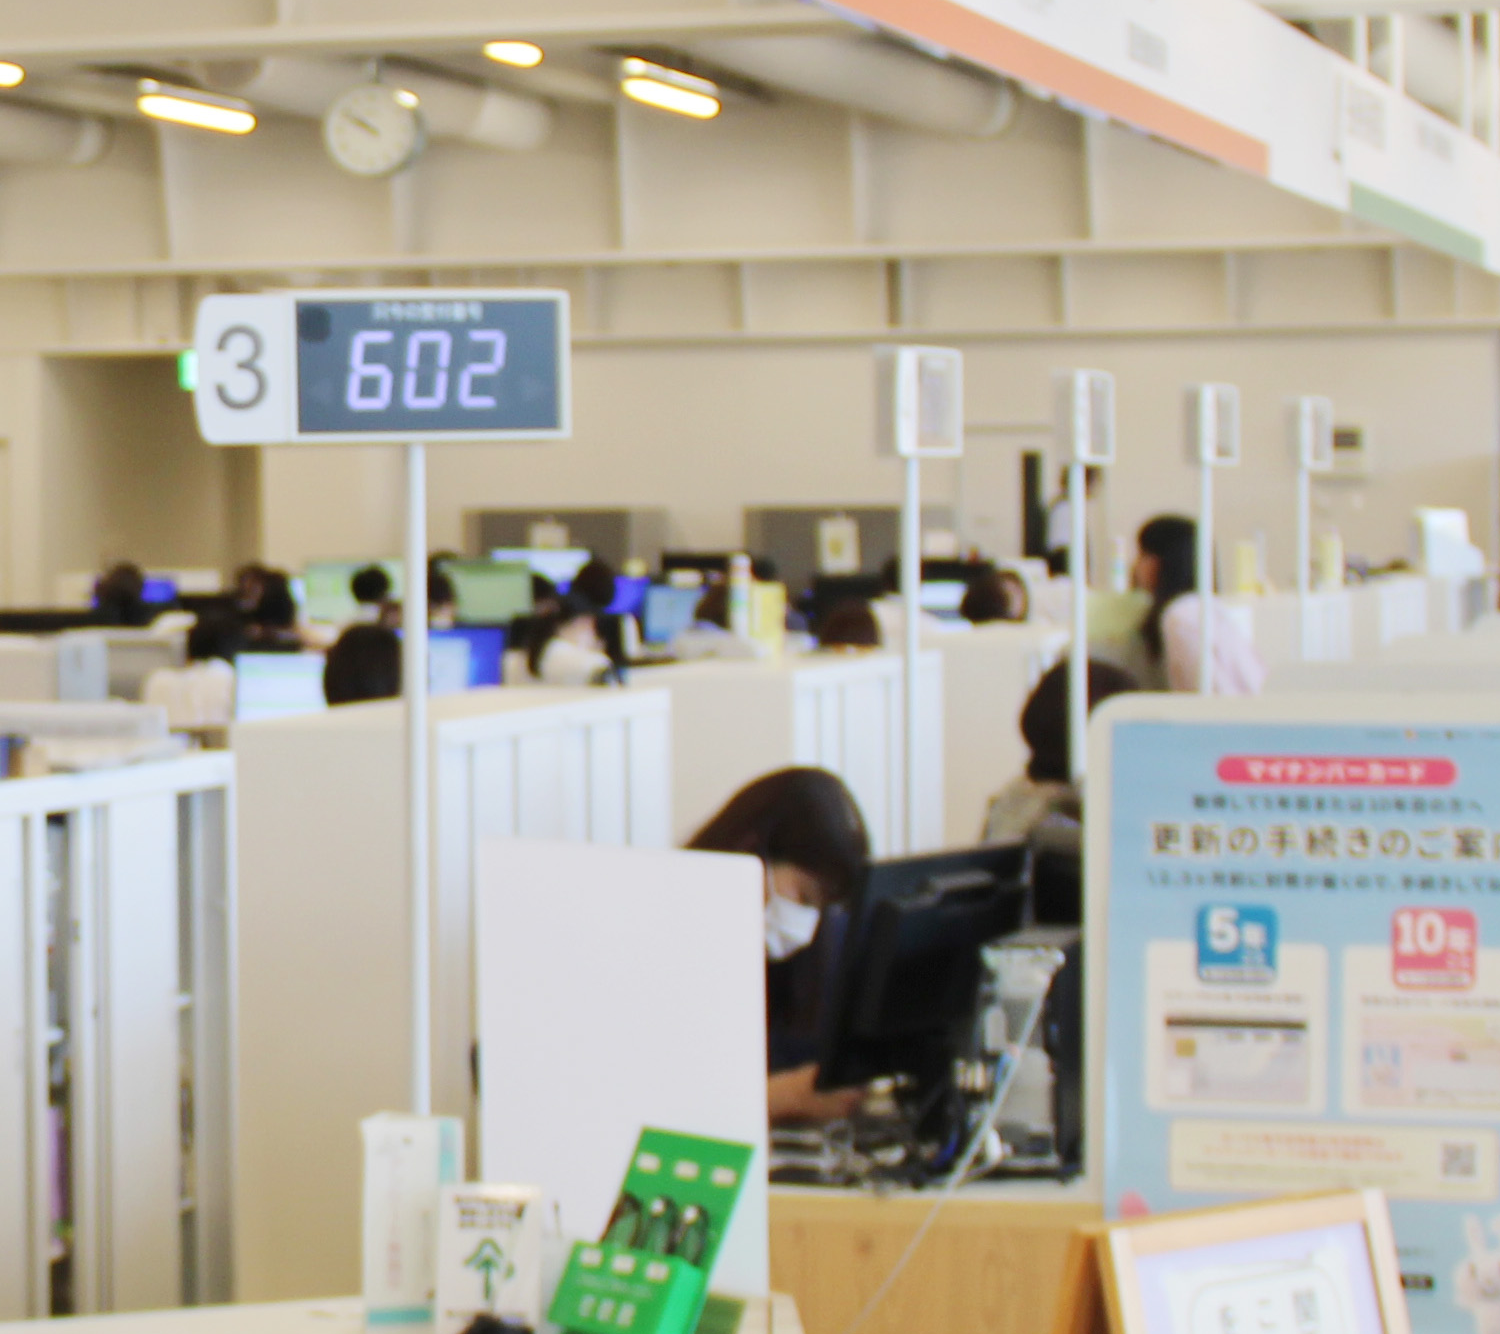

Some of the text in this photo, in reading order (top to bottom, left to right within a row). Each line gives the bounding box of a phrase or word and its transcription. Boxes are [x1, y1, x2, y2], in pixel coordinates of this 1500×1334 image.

[216, 324, 267, 410] 3
[346, 329, 507, 411] 602
[1246, 759, 1427, 782] マイナンバーカード
